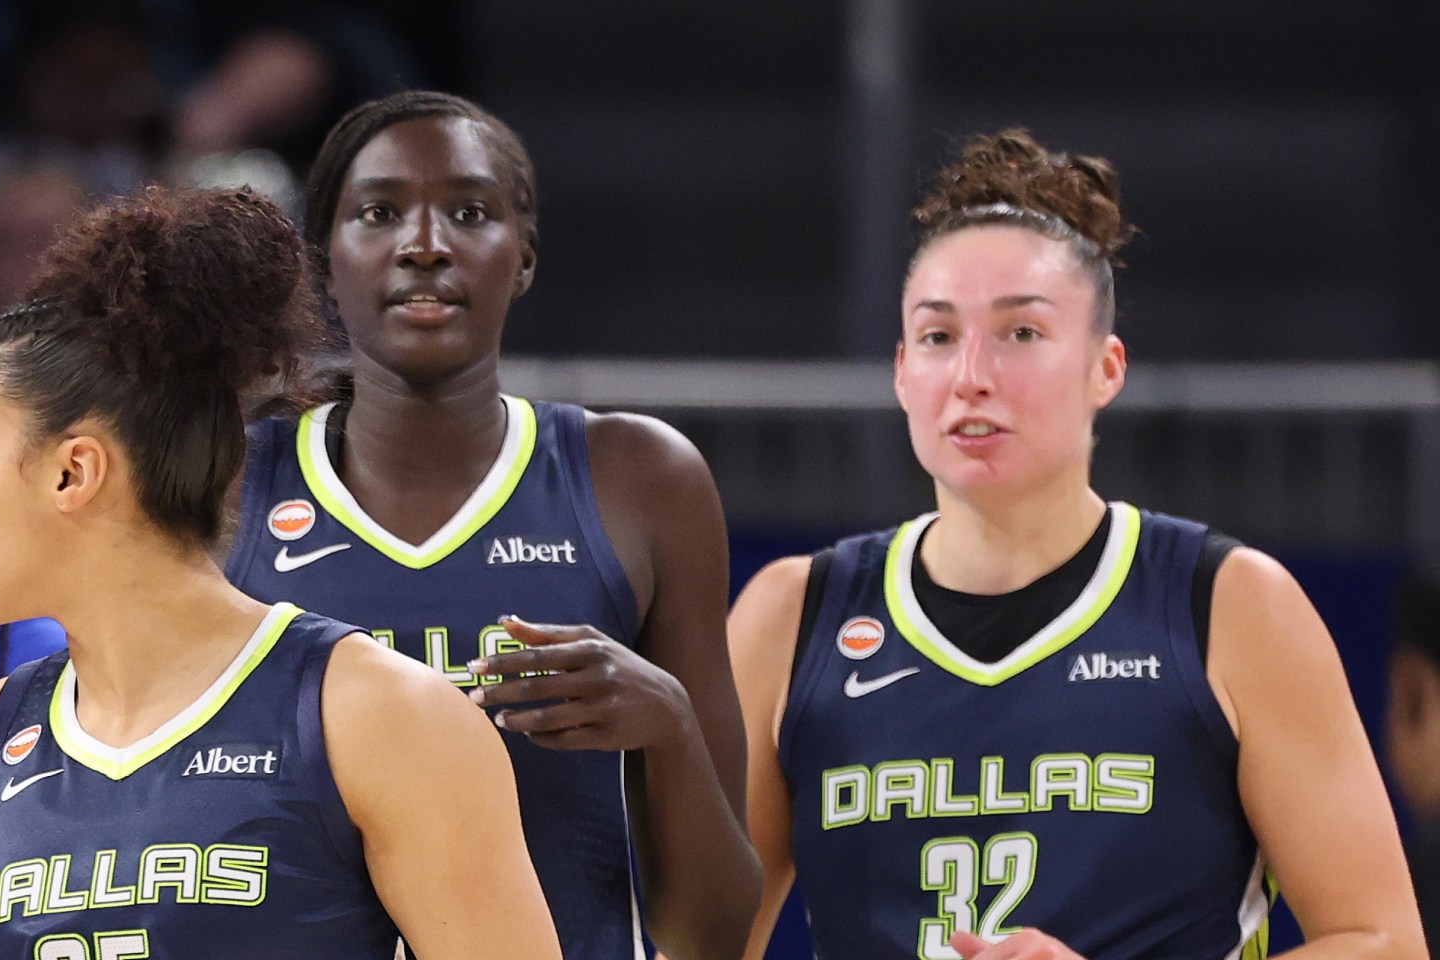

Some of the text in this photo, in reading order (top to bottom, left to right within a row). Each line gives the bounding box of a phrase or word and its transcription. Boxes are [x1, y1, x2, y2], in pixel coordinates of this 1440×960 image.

[487, 537, 577, 565] Albert
[1069, 652, 1161, 682] Albert
[182, 748, 277, 777] Albert
[822, 752, 1155, 830] DALLAS
